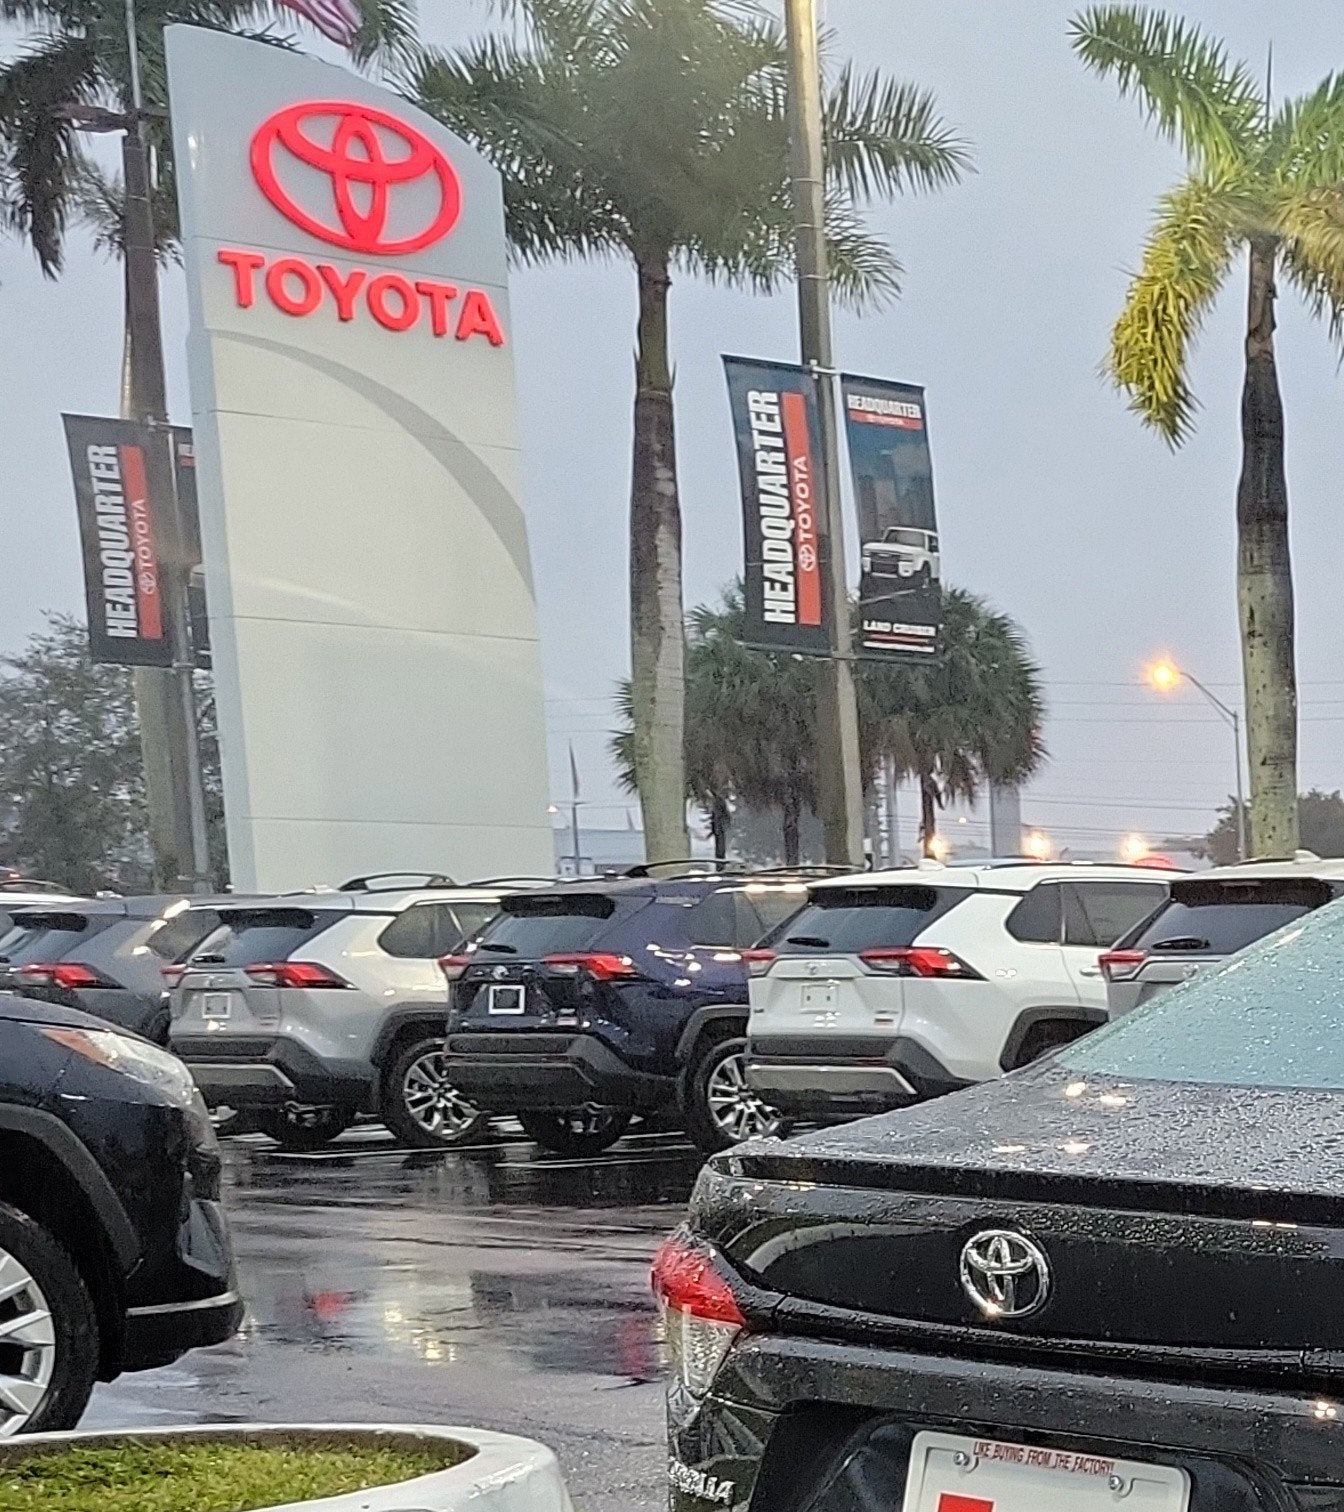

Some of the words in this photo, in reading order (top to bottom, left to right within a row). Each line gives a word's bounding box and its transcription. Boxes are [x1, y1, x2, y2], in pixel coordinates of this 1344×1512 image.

[217, 250, 503, 346] TOYOTA
[87, 444, 137, 638] HEADQUARTER
[131, 499, 155, 568] TOYOTA
[748, 390, 796, 624] HEADQUARTER
[793, 456, 812, 542] TOYOTA
[973, 1442, 992, 1456] LIKE
[992, 1443, 1024, 1463] BUYING
[1026, 1449, 1052, 1466] FROM
[1052, 1453, 1071, 1469] THE
